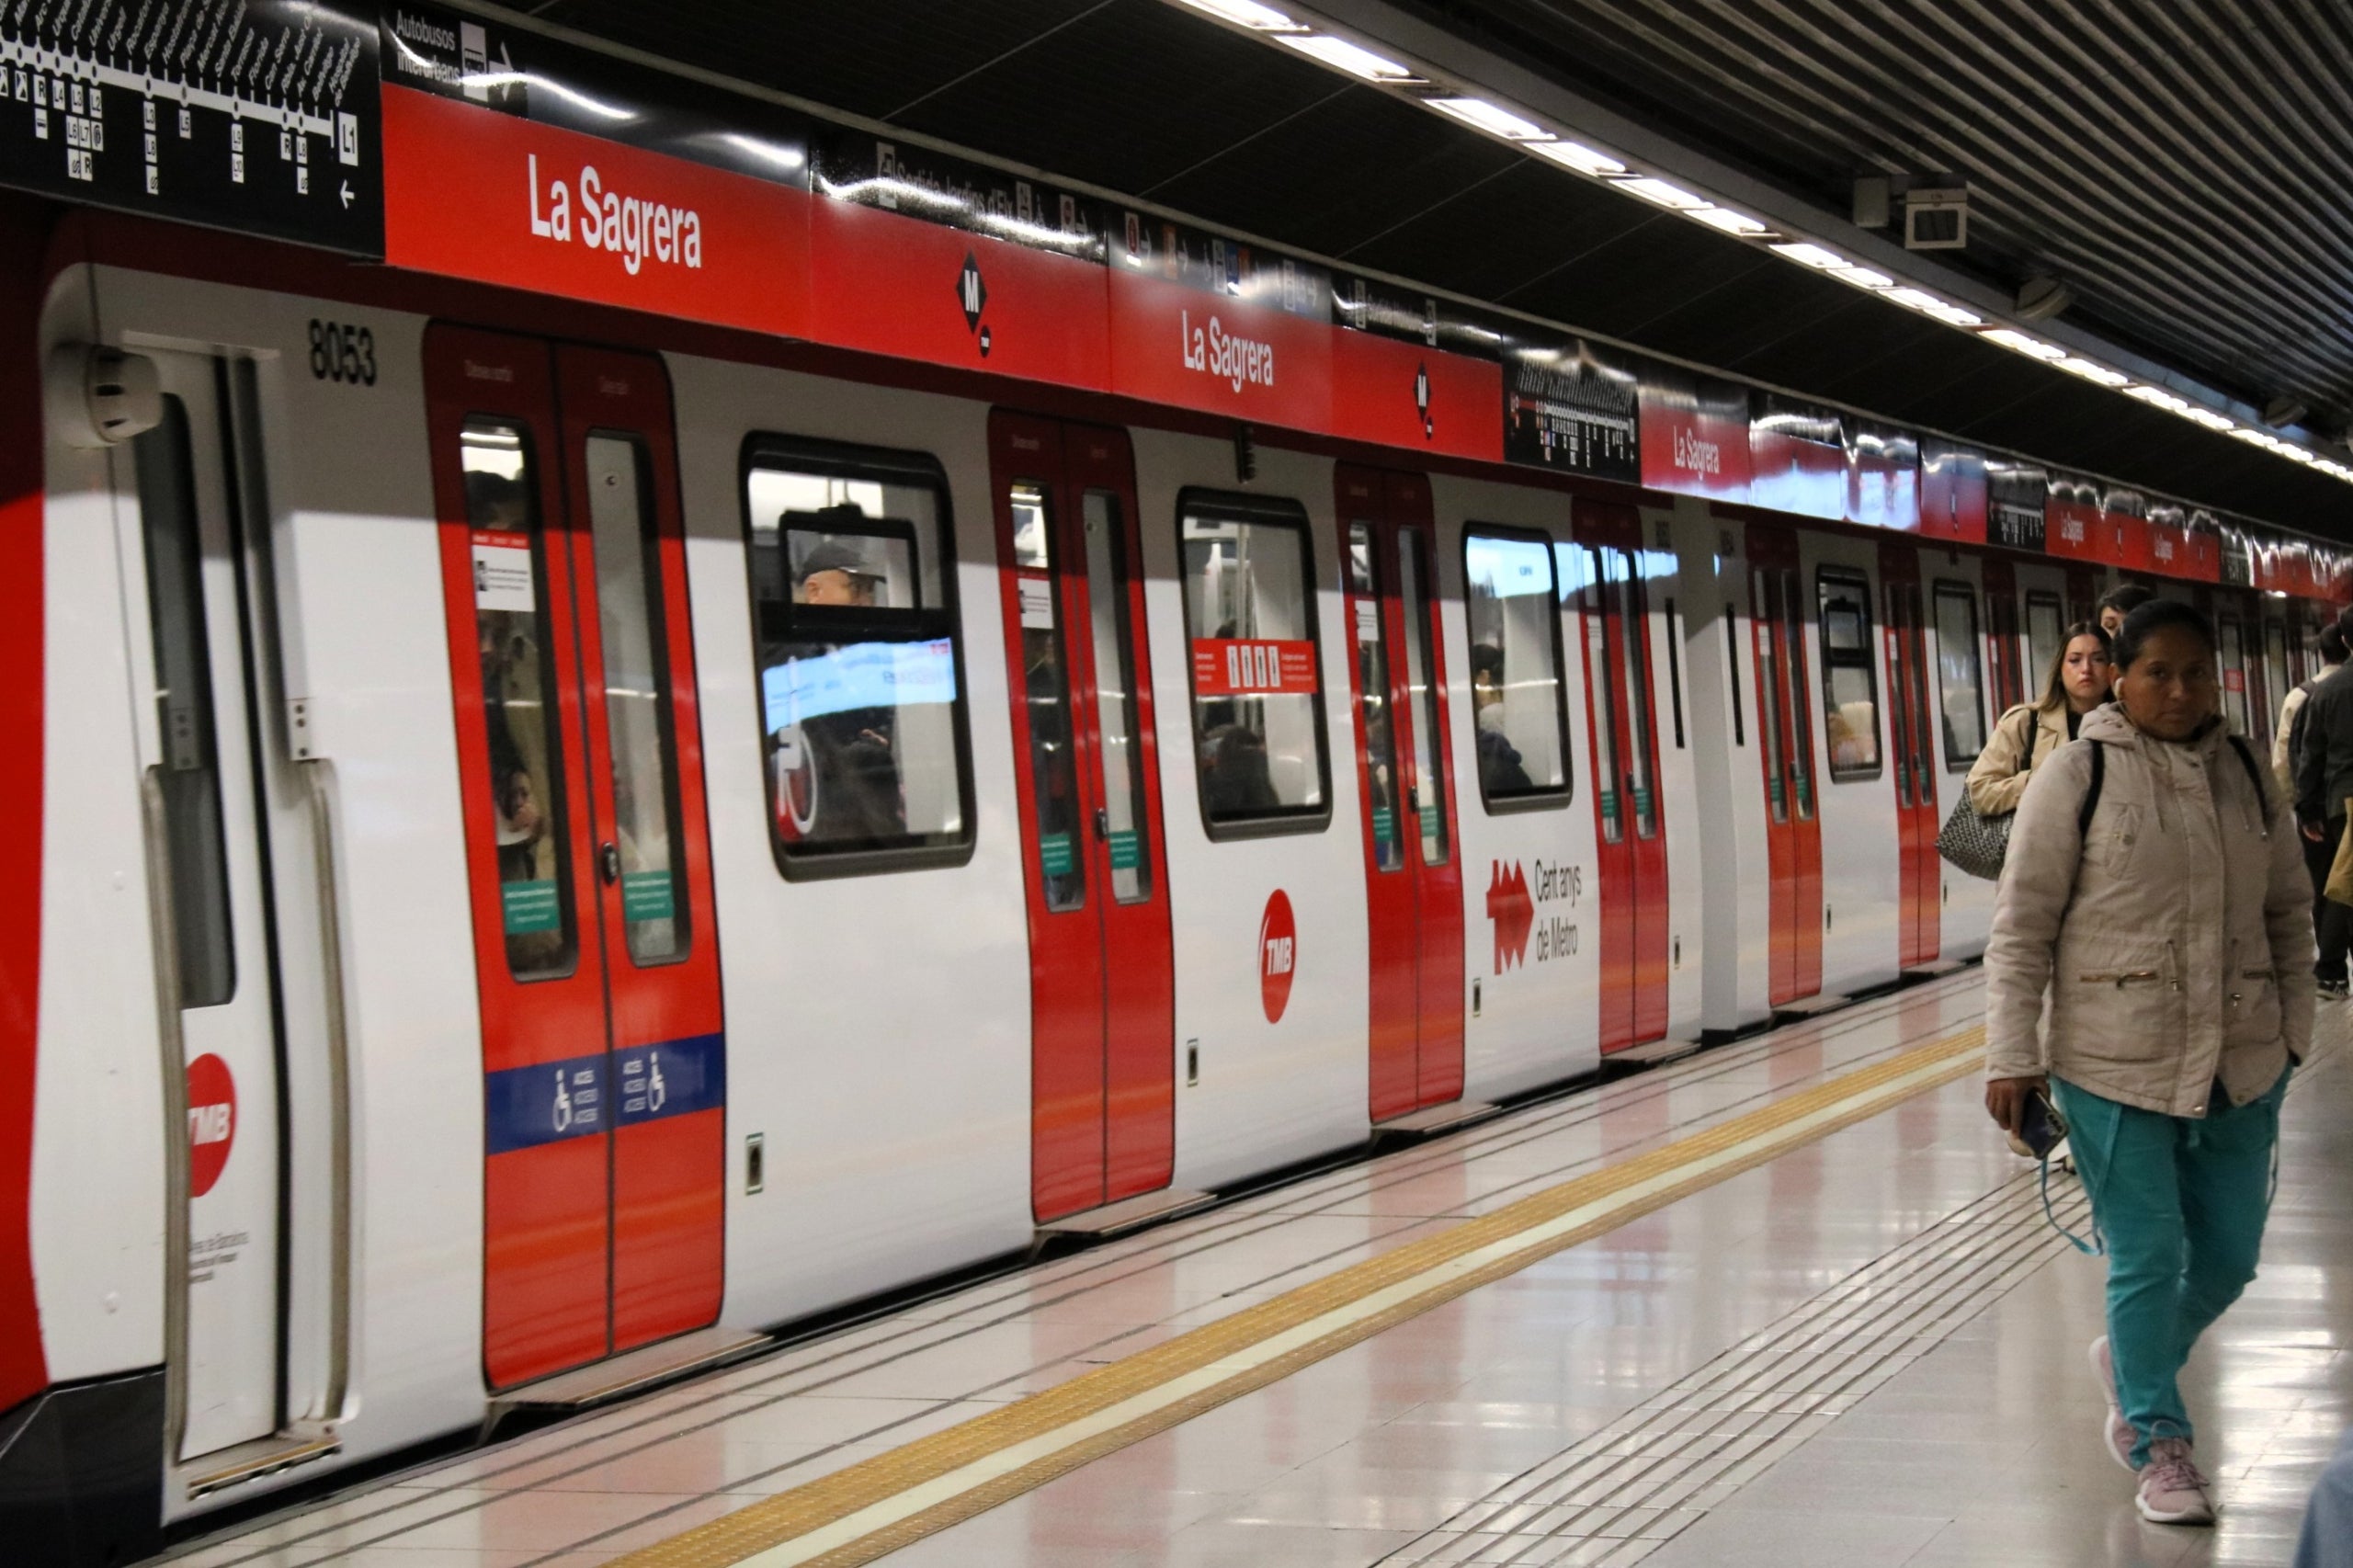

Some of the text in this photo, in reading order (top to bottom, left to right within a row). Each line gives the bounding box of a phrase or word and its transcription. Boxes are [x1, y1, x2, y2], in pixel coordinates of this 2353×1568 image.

[396, 9, 455, 51] Autobusos
[53, 85, 63, 104] L4
[73, 89, 83, 108] L3
[92, 94, 101, 112] L2
[67, 123, 77, 140] L6
[79, 125, 90, 142] L7
[144, 109, 155, 125] L3
[343, 124, 355, 154] L1
[85, 156, 92, 174] R
[529, 153, 701, 276] La Sagrera
[964, 269, 980, 313] M
[308, 318, 377, 386] 8053
[1182, 309, 1273, 393] La Sagrera
[1673, 425, 1686, 468] La
[1687, 427, 1720, 482] Sagrera
[1534, 859, 1582, 907] Cent anys
[1267, 937, 1292, 975] TMB
[1536, 917, 1578, 962] de Metro
[188, 1103, 230, 1145] TMB
